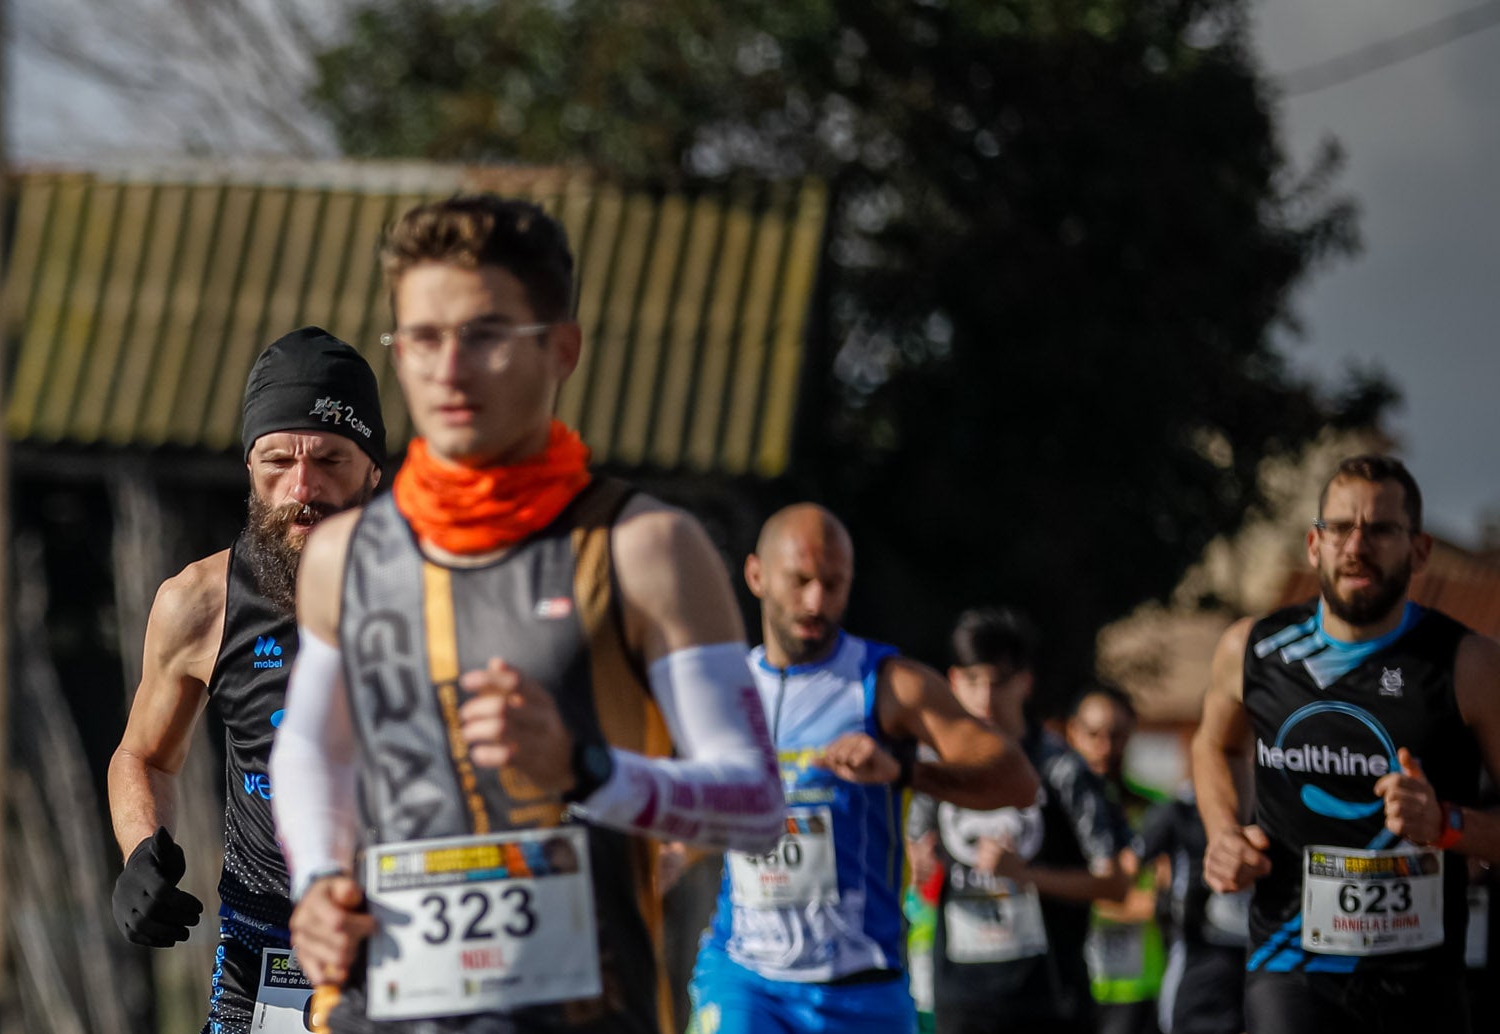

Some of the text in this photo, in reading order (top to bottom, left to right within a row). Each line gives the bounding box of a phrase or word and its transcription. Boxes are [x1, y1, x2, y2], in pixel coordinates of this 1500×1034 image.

[254, 659, 283, 669] mobel
[1257, 737, 1389, 777] healthine
[1339, 882, 1412, 913] 623
[421, 886, 539, 945] 323
[1333, 915, 1381, 932] DANIELA
[271, 957, 289, 970] 26
[270, 975, 310, 986] Ruta de los
